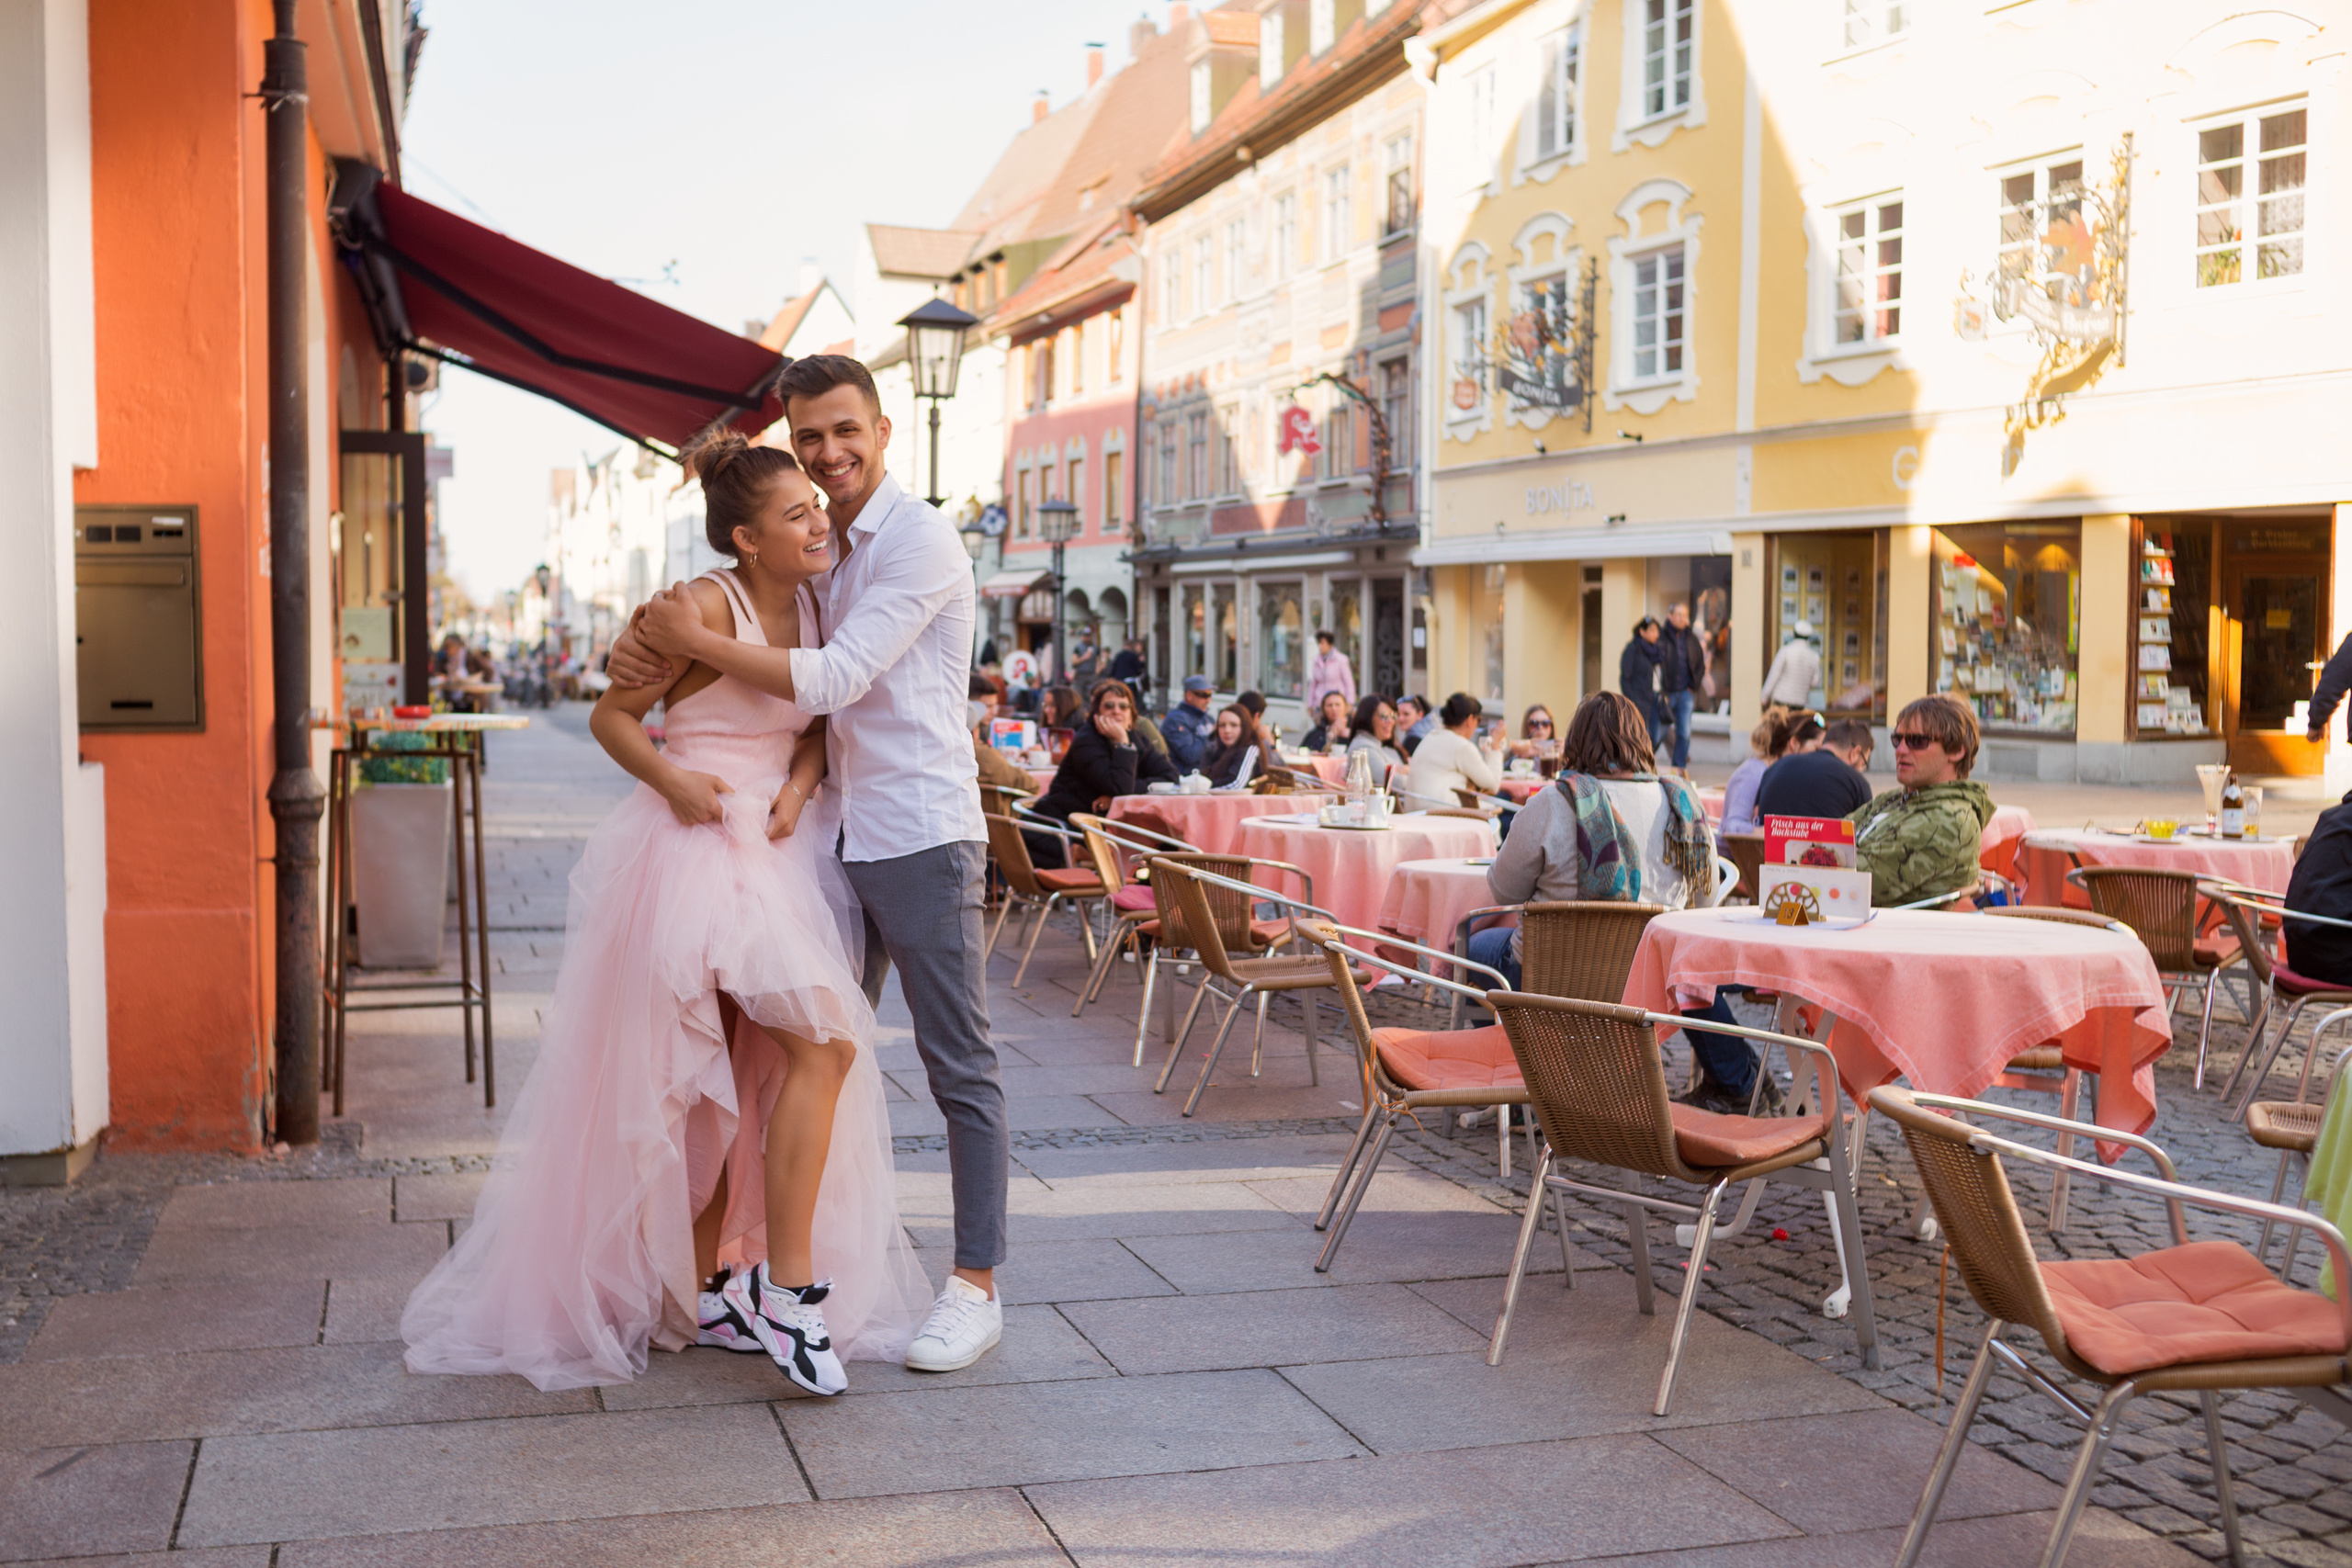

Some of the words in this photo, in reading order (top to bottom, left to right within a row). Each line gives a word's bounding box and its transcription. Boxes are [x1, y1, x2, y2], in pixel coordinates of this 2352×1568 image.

[1512, 380, 1561, 404] BONITA
[1525, 476, 1594, 518] BONITA
[1770, 818, 1793, 829] Frisch
[1795, 821, 1809, 829] aus
[1811, 821, 1824, 831] der
[1770, 827, 1809, 839] Backstube
[1783, 907, 1794, 919] 13
